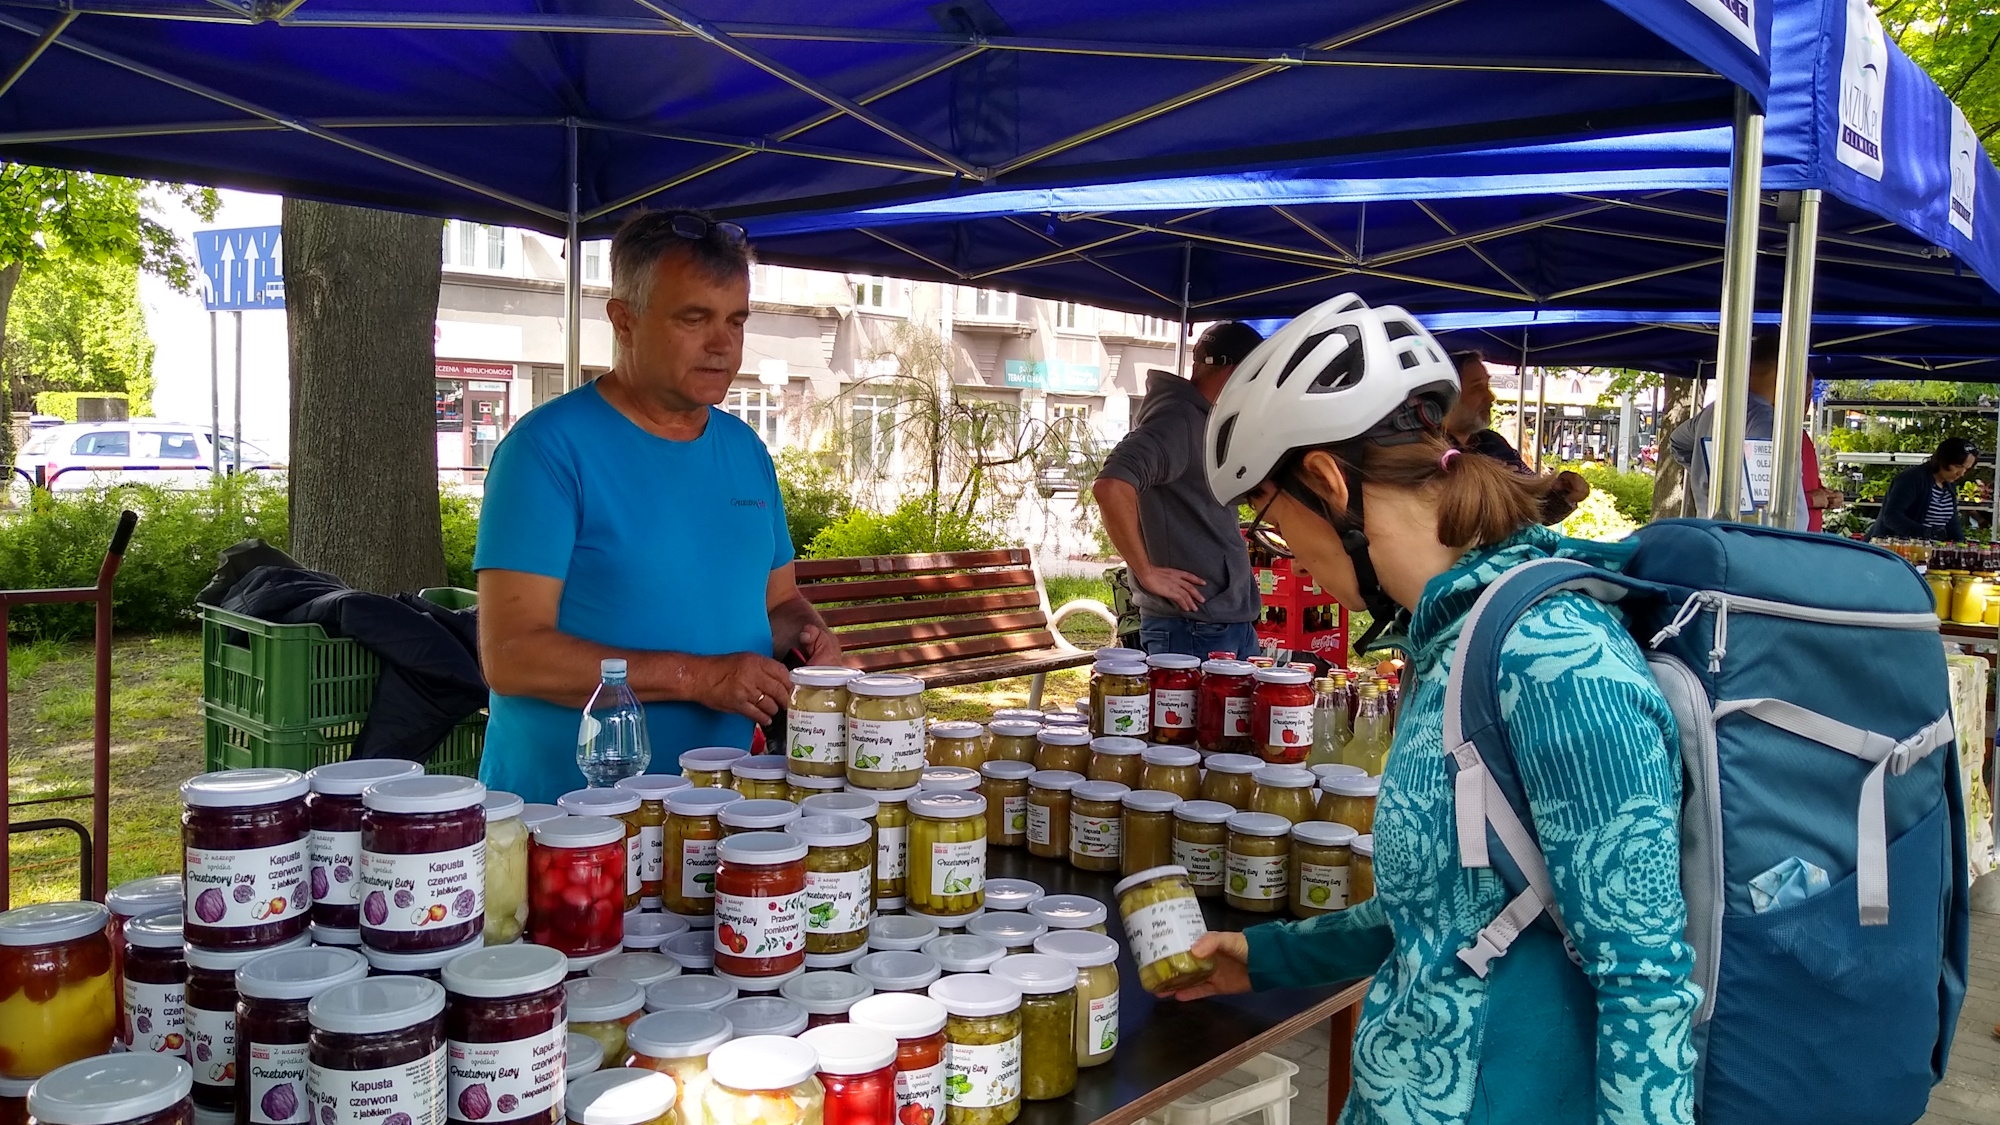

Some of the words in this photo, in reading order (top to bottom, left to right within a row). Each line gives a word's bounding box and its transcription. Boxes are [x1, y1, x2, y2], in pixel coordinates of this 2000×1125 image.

[1844, 127, 1878, 159] GLIWICE
[463, 366, 512, 376] NIERUCHOMOŚCI
[269, 851, 301, 866] Kapusta
[334, 854, 354, 868] Ewy
[268, 864, 303, 880] czerwona
[429, 859, 464, 874] Kapusta
[188, 870, 232, 887] Przetwory
[233, 872, 256, 886] Ewy
[394, 878, 415, 890] Ewy
[427, 871, 468, 887] czerwona
[838, 890, 852, 901] Ewy
[742, 915, 758, 927] Ewy
[771, 912, 796, 924] Przecier
[764, 923, 799, 938] pomidorowy
[136, 1003, 153, 1018] Ewy
[196, 1031, 213, 1046] Ewy
[252, 1051, 270, 1060] POLSKI
[281, 1047, 309, 1055] naszego
[474, 1049, 500, 1057] naszego
[277, 1057, 304, 1066] ogródka
[471, 1058, 496, 1066] ogródka
[531, 1050, 562, 1072] czerwona
[252, 1066, 305, 1081] Przetwory
[450, 1065, 496, 1082] Przetwory
[498, 1067, 520, 1079] Ewy
[972, 1064, 988, 1075] Ewy
[320, 1091, 338, 1109] Ewy
[351, 1078, 393, 1094] Kapusta
[349, 1093, 398, 1107] czerwona
[359, 1107, 392, 1120] jabłkiem
